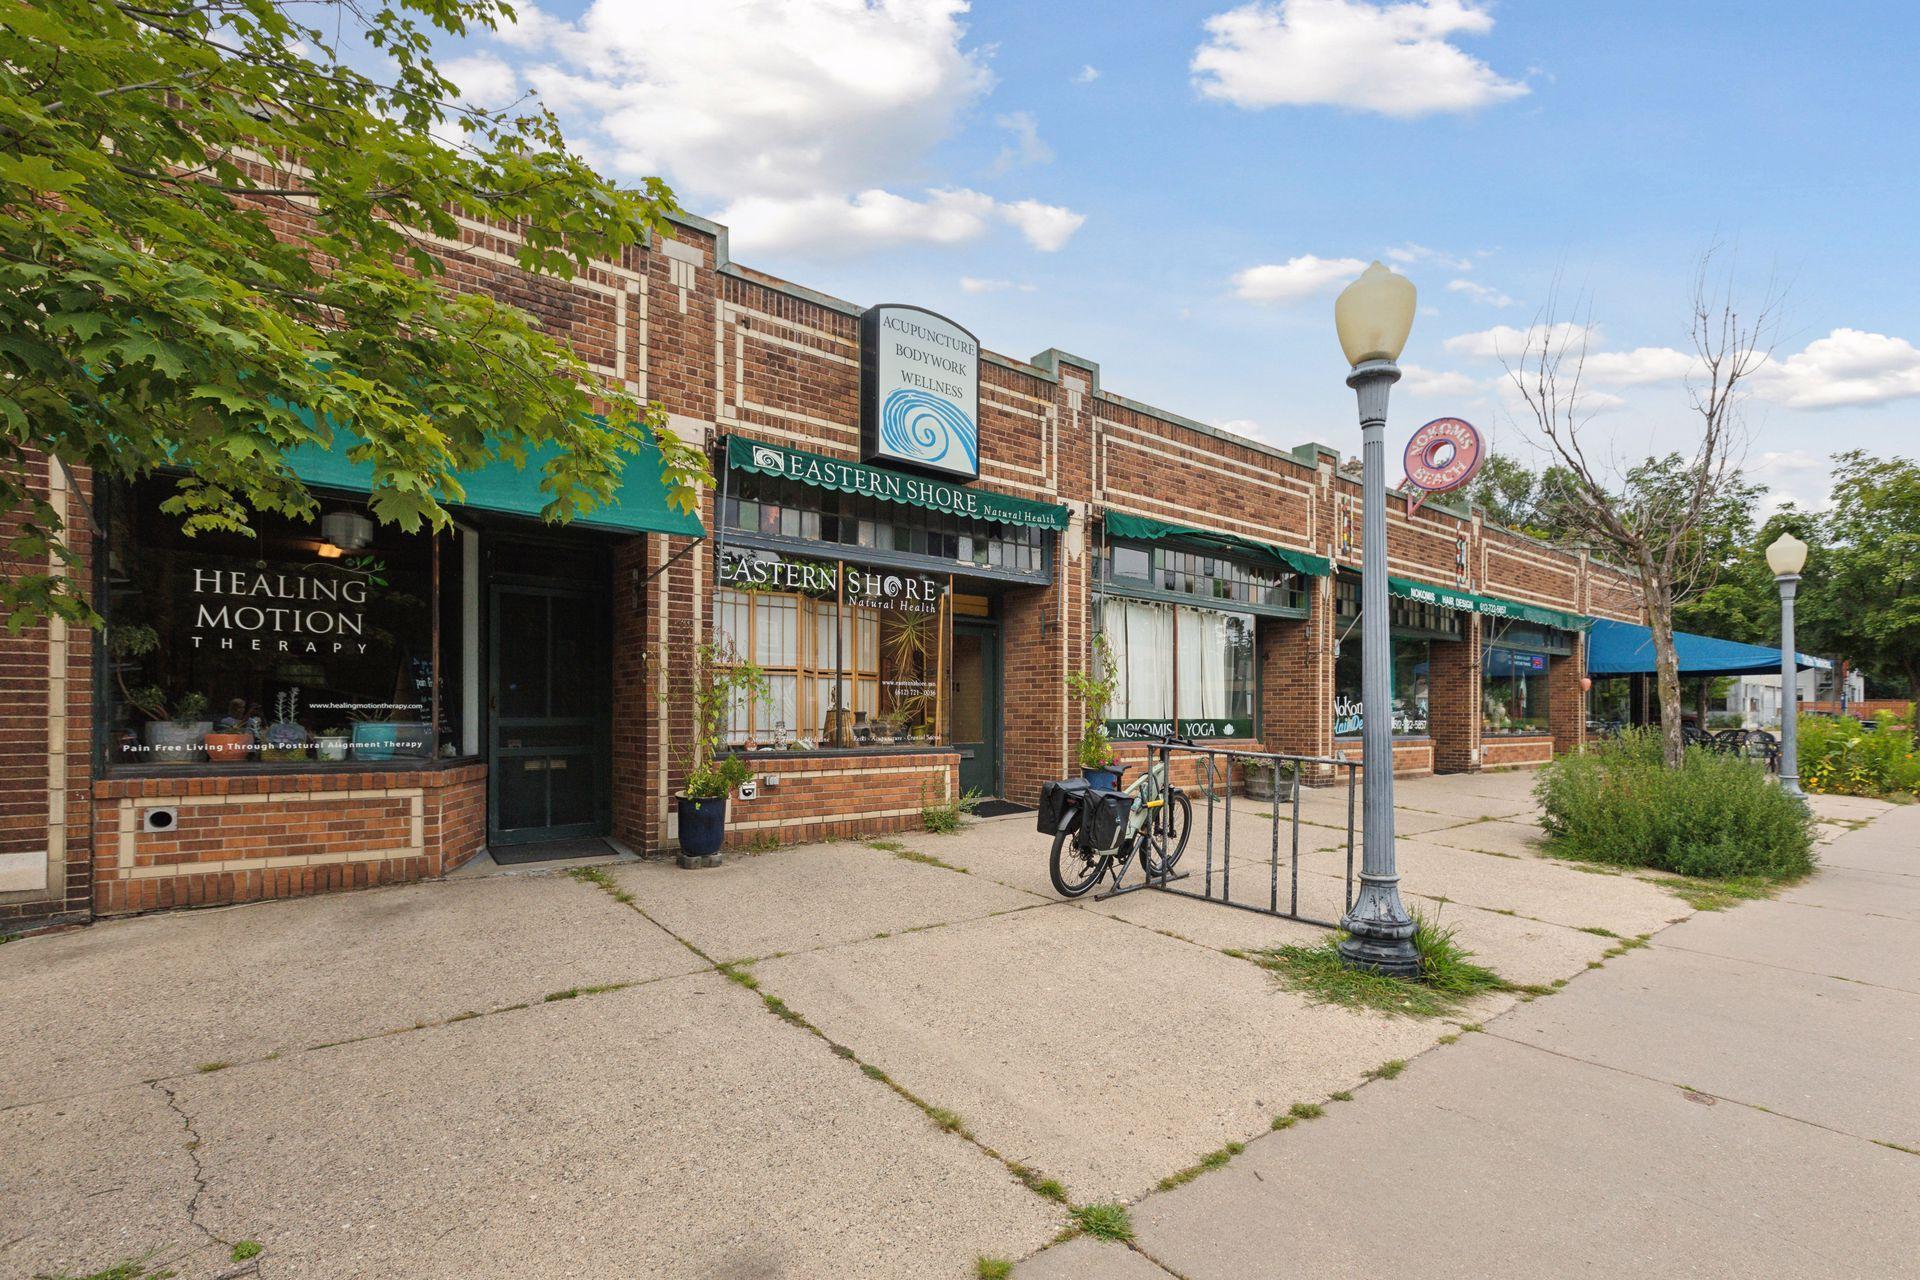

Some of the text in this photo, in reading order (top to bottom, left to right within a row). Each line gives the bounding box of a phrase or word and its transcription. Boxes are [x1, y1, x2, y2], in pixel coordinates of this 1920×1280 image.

[883, 316, 975, 356] ACUPUNCTURE
[896, 343, 967, 376] BODYWORK
[901, 370, 963, 399] WELLNESS
[789, 454, 1056, 524] EASTERN SHORE Natural Health
[193, 568, 367, 603] HEALING
[718, 556, 936, 601] EASTERN SHORE
[194, 603, 363, 636] MOTION
[849, 596, 936, 613] Natural Health
[191, 636, 367, 654] THERAPY
[309, 702, 423, 711] www.healingmotiontherapy.com
[123, 740, 423, 752] Pain Free Living Through Postural Alignment Therapy
[1116, 723, 1216, 738] NOKOMIS YOGA
